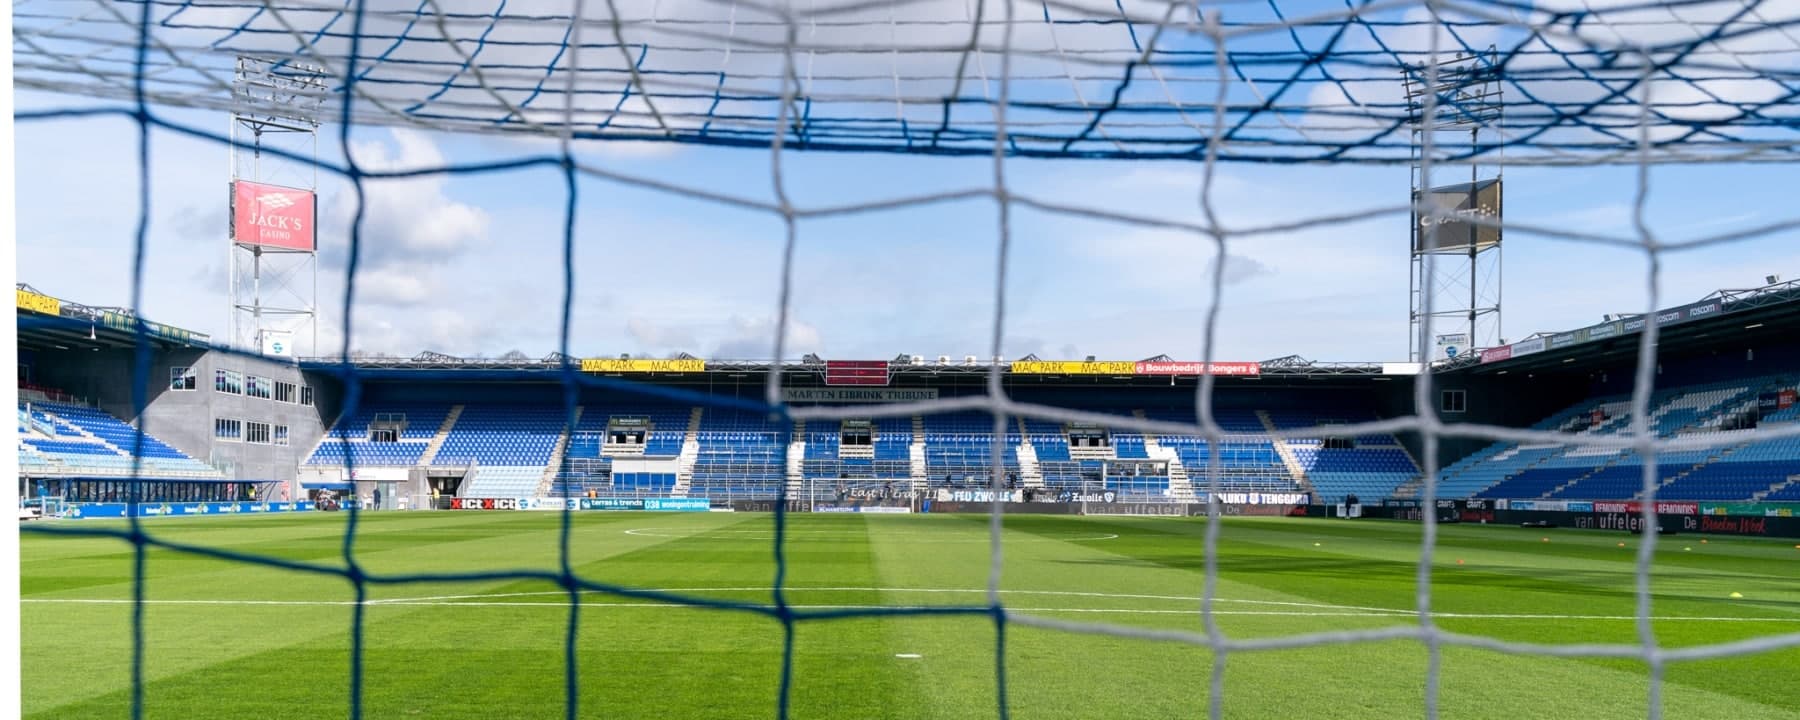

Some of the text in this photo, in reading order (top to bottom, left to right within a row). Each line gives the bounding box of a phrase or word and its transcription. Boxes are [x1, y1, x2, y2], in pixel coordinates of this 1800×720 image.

[248, 213, 302, 231] JACK'S
[260, 229, 291, 240] CASINO
[1689, 303, 1715, 317] roscom
[583, 360, 634, 371] MAC PARK
[651, 360, 703, 371] MAC PARK
[1013, 362, 1065, 373] MAC PARK
[1081, 362, 1134, 373] MAC PARK
[1146, 363, 1204, 374] Bouwbedrijf
[788, 390, 935, 400] MARTEN EIBRINK TRIBUNE
[974, 491, 1010, 502] ZWOLE
[744, 502, 770, 512] van
[1657, 503, 1695, 514] REMONDIS
[1575, 513, 1645, 530] van uffelen
[1684, 516, 1697, 529] De
